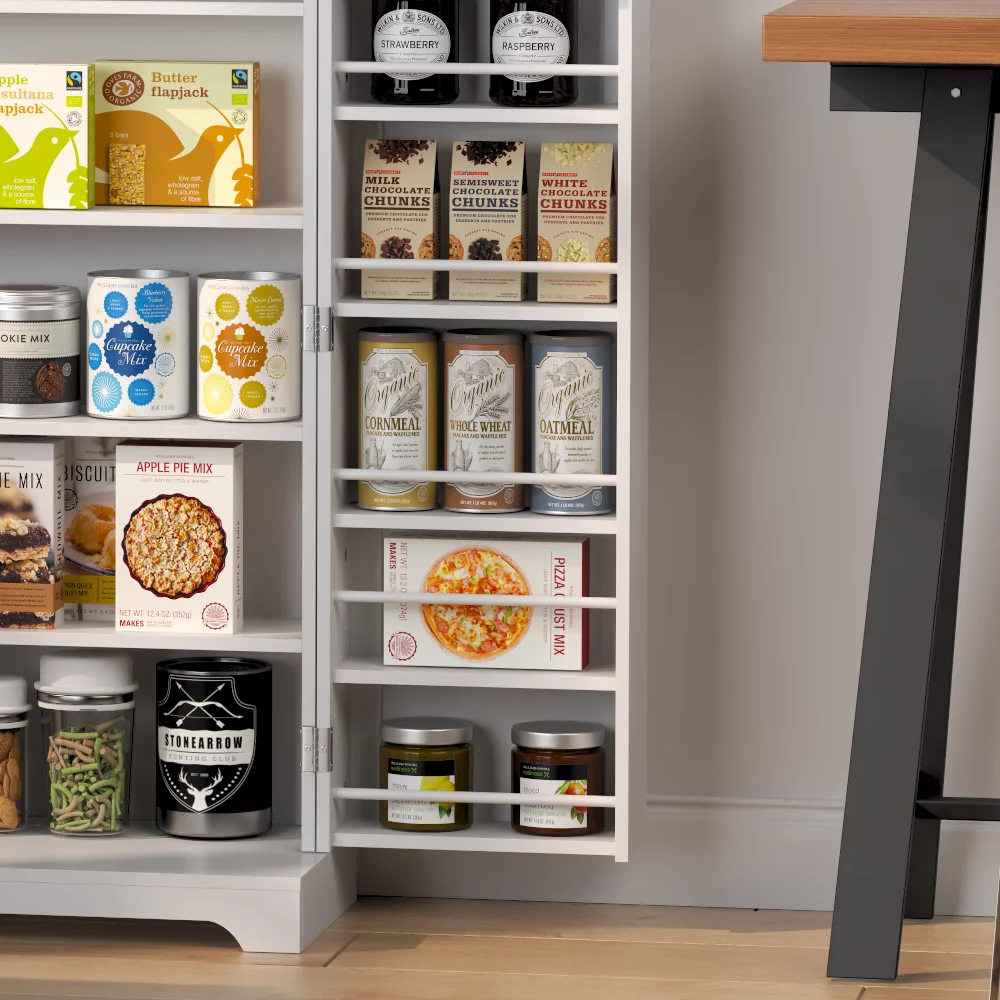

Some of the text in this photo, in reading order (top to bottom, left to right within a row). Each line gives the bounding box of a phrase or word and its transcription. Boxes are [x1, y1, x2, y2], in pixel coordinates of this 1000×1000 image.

[418, 15, 435, 25] SONS
[435, 23, 445, 34] LTD
[537, 16, 553, 27] SONS
[554, 24, 564, 36] LTD
[381, 40, 439, 48] STRAWBERRY
[503, 42, 555, 50] RASPBERRY
[151, 72, 198, 83] Butter
[1, 89, 54, 100] sultana
[151, 86, 209, 100] flapjack
[365, 177, 400, 185] MILK
[542, 179, 587, 188] WHITE
[364, 196, 430, 207] CHUNKS
[452, 198, 518, 208] CHUNKS
[540, 199, 607, 209] CHUNKS
[30, 334, 50, 343] MIX
[106, 337, 152, 354] Cupcake
[217, 340, 264, 356] Cupcake
[118, 352, 147, 365] Mix
[229, 354, 259, 367] Mix
[364, 366, 419, 413] Organic
[450, 368, 506, 414] Organic
[538, 370, 593, 418] Organic
[365, 416, 421, 430] CORNMEAL
[450, 420, 512, 432] WHOLE WHEAT
[540, 420, 594, 435] OATMEAL
[137, 462, 213, 474] APPLE PIE MIX
[19, 472, 43, 489] MIX
[554, 558, 566, 656] PIZZA MIX
[172, 611, 192, 619] (352g)
[165, 734, 242, 749] STONEARROW
